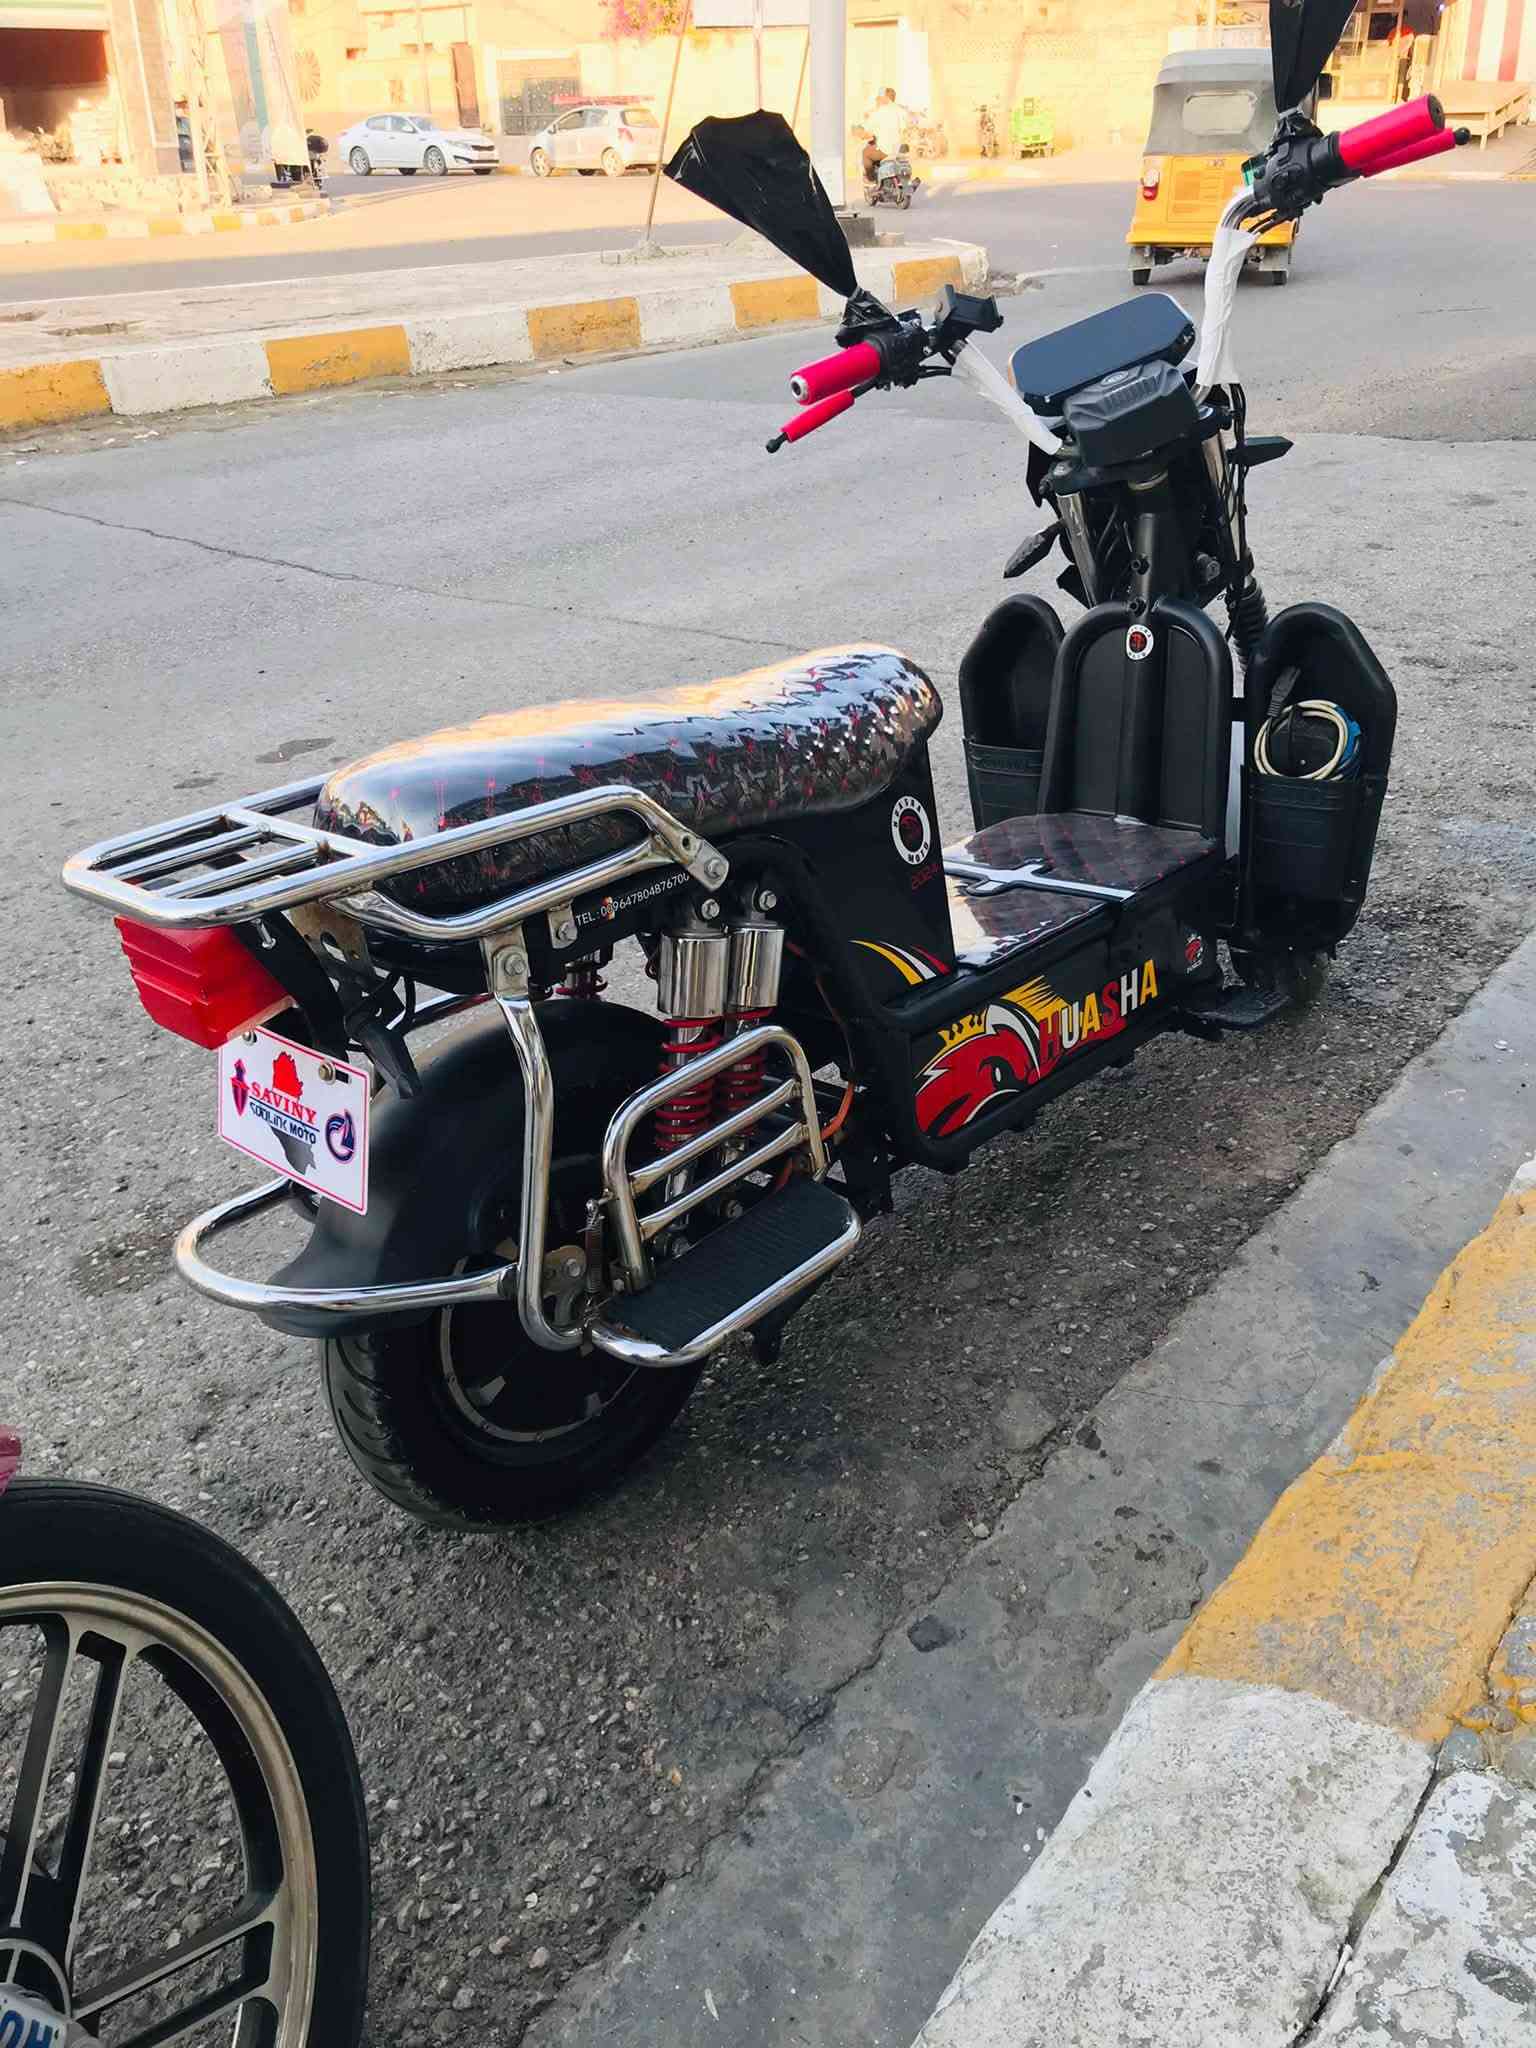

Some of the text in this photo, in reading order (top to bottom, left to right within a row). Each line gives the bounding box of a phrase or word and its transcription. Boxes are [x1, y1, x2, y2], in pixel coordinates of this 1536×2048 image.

[1039, 959, 1159, 1060] HUASHA
[250, 1081, 317, 1125] SAVINY
[289, 1121, 317, 1145] MOTO
